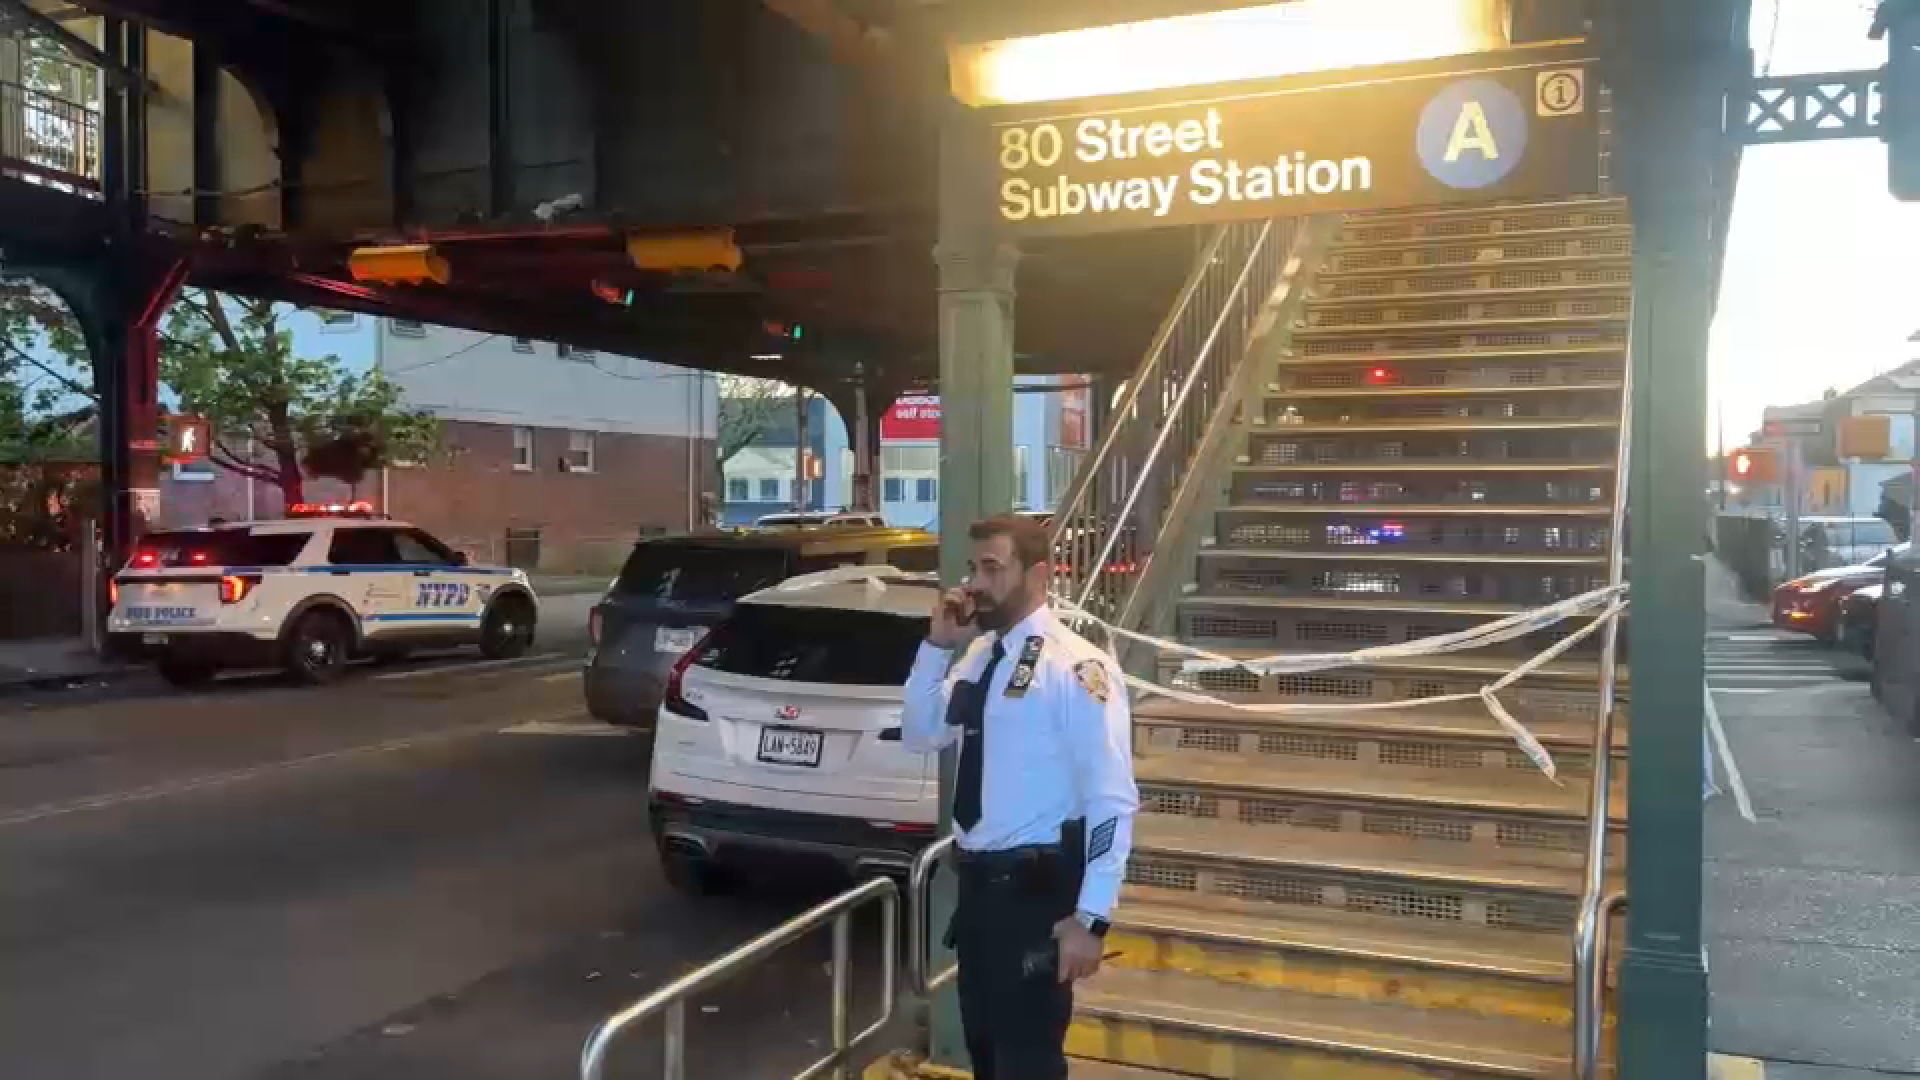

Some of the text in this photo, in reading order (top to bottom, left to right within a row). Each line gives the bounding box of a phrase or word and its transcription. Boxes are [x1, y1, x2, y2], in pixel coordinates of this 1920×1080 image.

[1000, 108, 1223, 171] 80 Street
[1442, 99, 1499, 162] A
[1000, 151, 1371, 221] Subway Station
[155, 606, 197, 619] POLICE
[416, 583, 469, 607] NYPD
